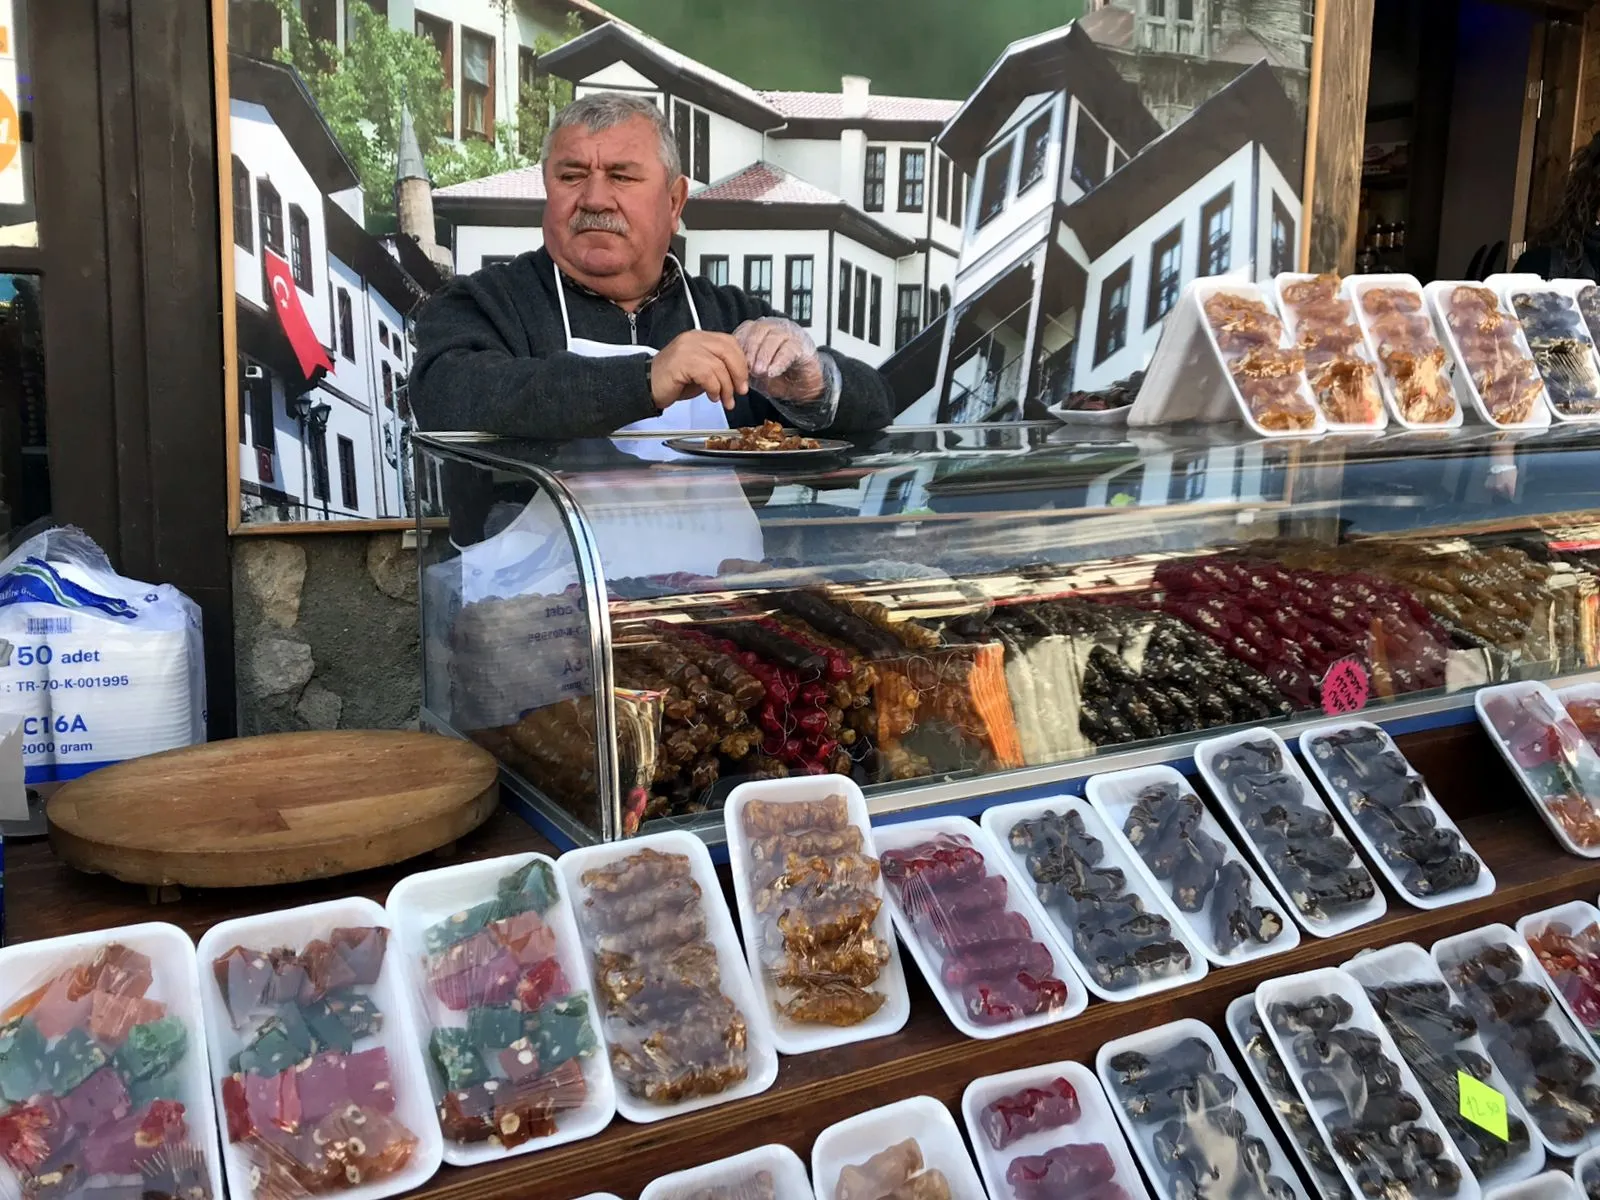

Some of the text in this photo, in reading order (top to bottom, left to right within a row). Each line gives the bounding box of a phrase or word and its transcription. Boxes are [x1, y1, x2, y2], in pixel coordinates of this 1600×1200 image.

[61, 650, 101, 664] adet
[16, 675, 129, 692] TR-70-K-001995
[23, 714, 88, 736] C16A
[60, 740, 93, 755] gram
